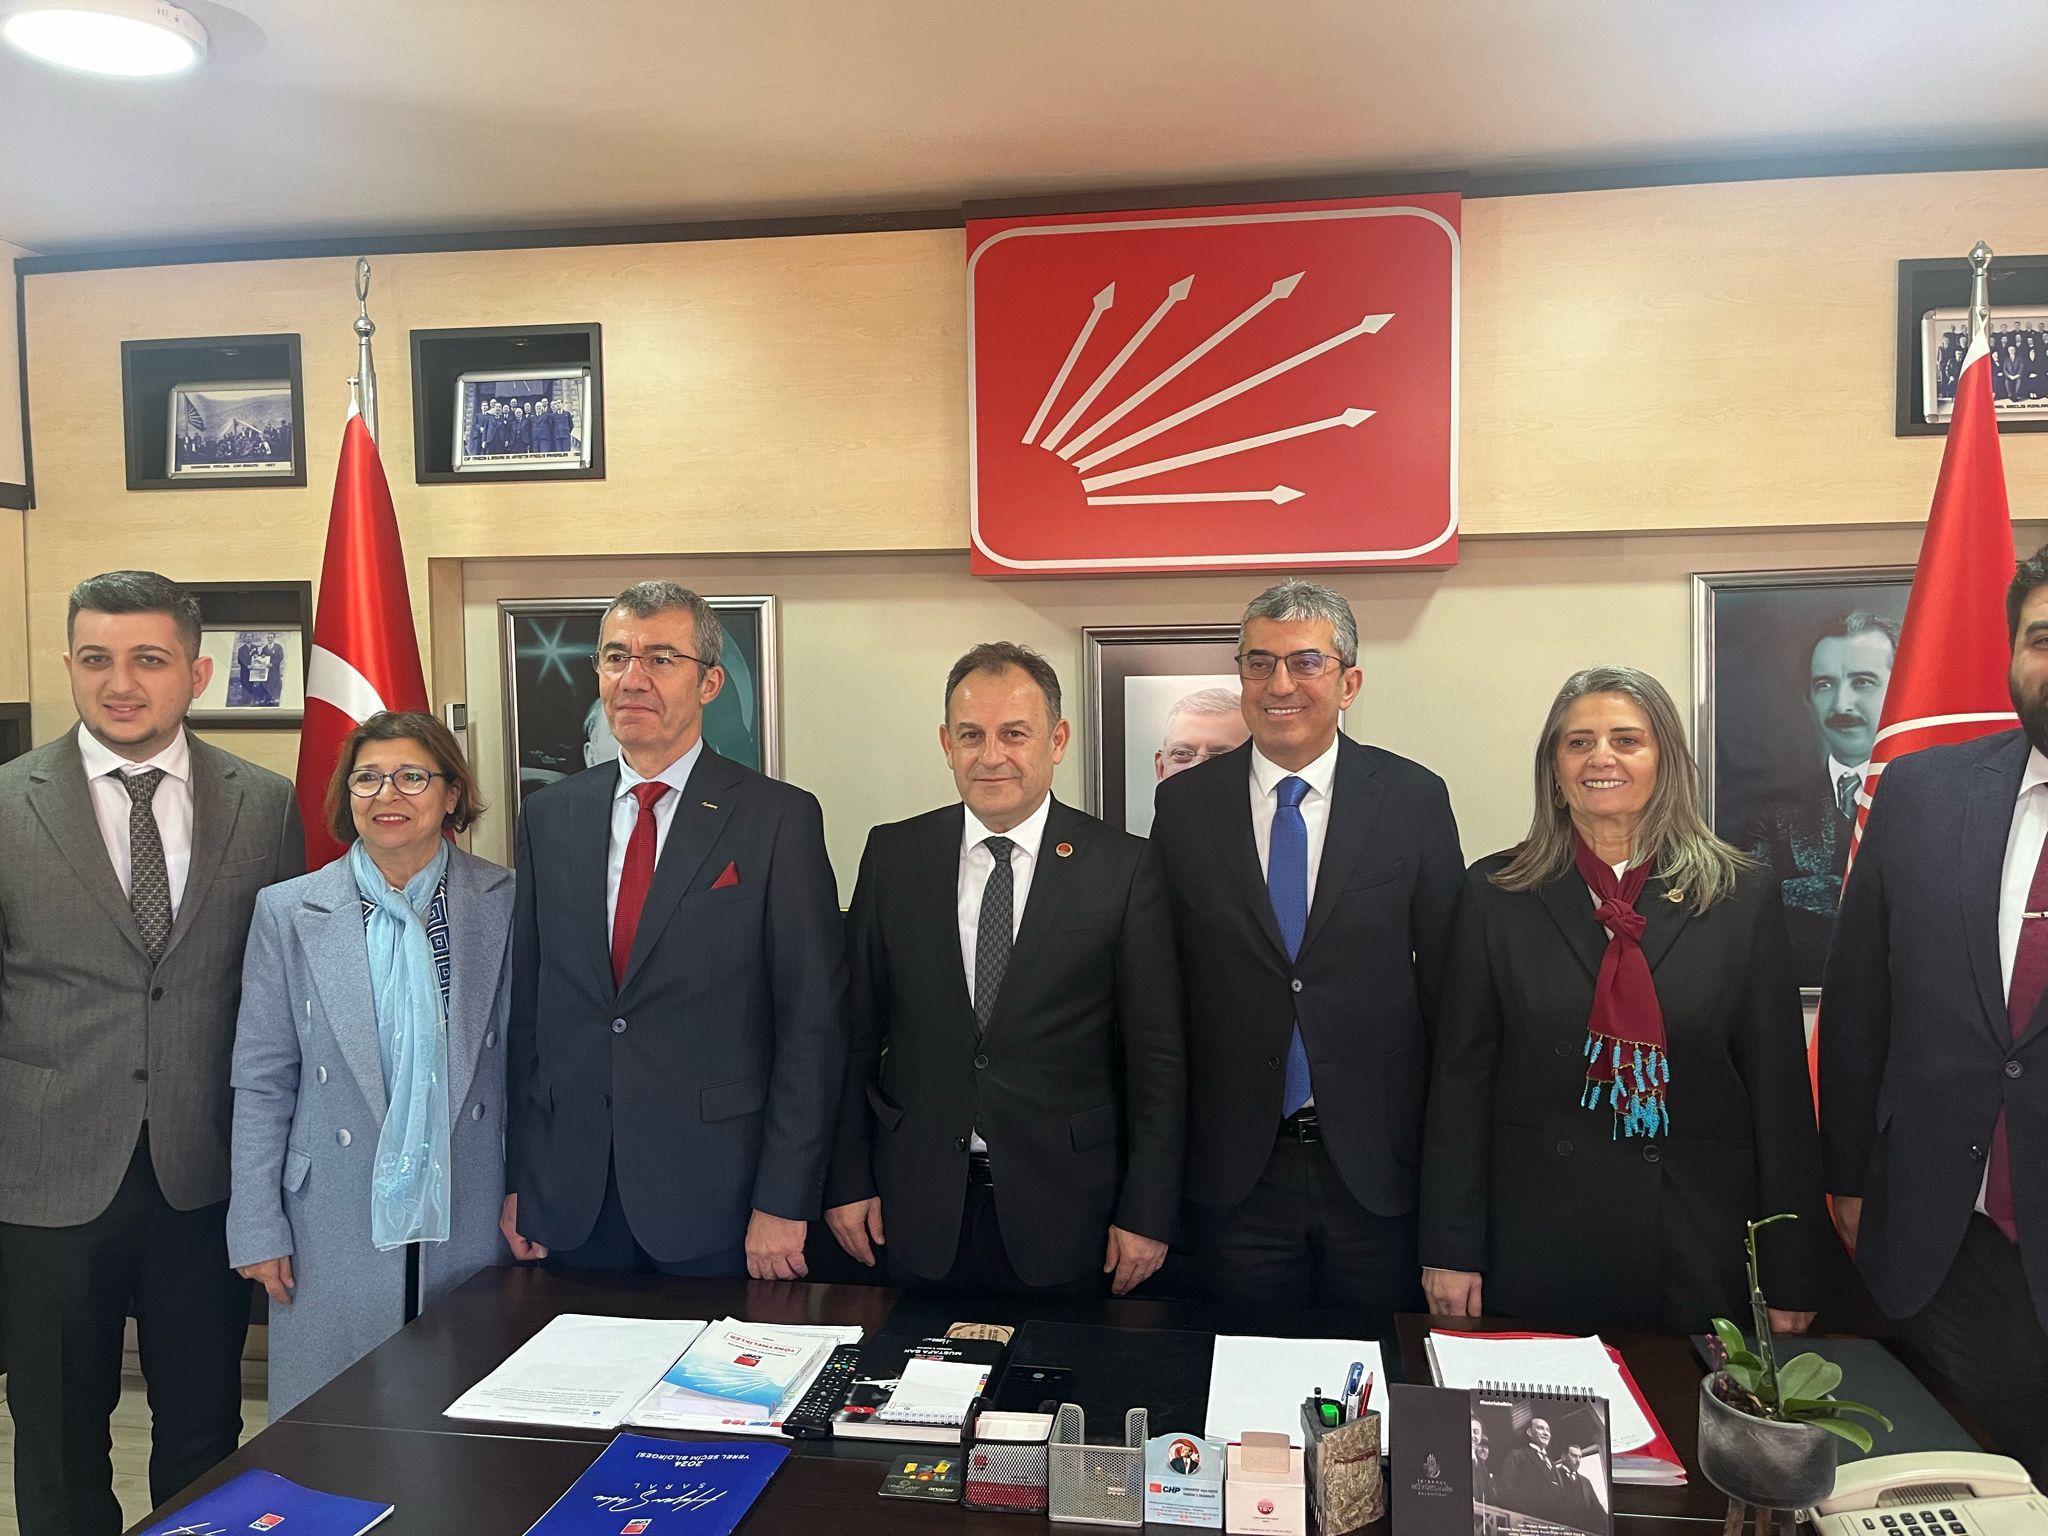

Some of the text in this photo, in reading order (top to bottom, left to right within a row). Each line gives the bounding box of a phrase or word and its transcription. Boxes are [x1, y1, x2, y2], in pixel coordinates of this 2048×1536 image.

[674, 1460, 704, 1468] 2024
[634, 1482, 707, 1490] SARAL
[1162, 1485, 1181, 1494] CHP
